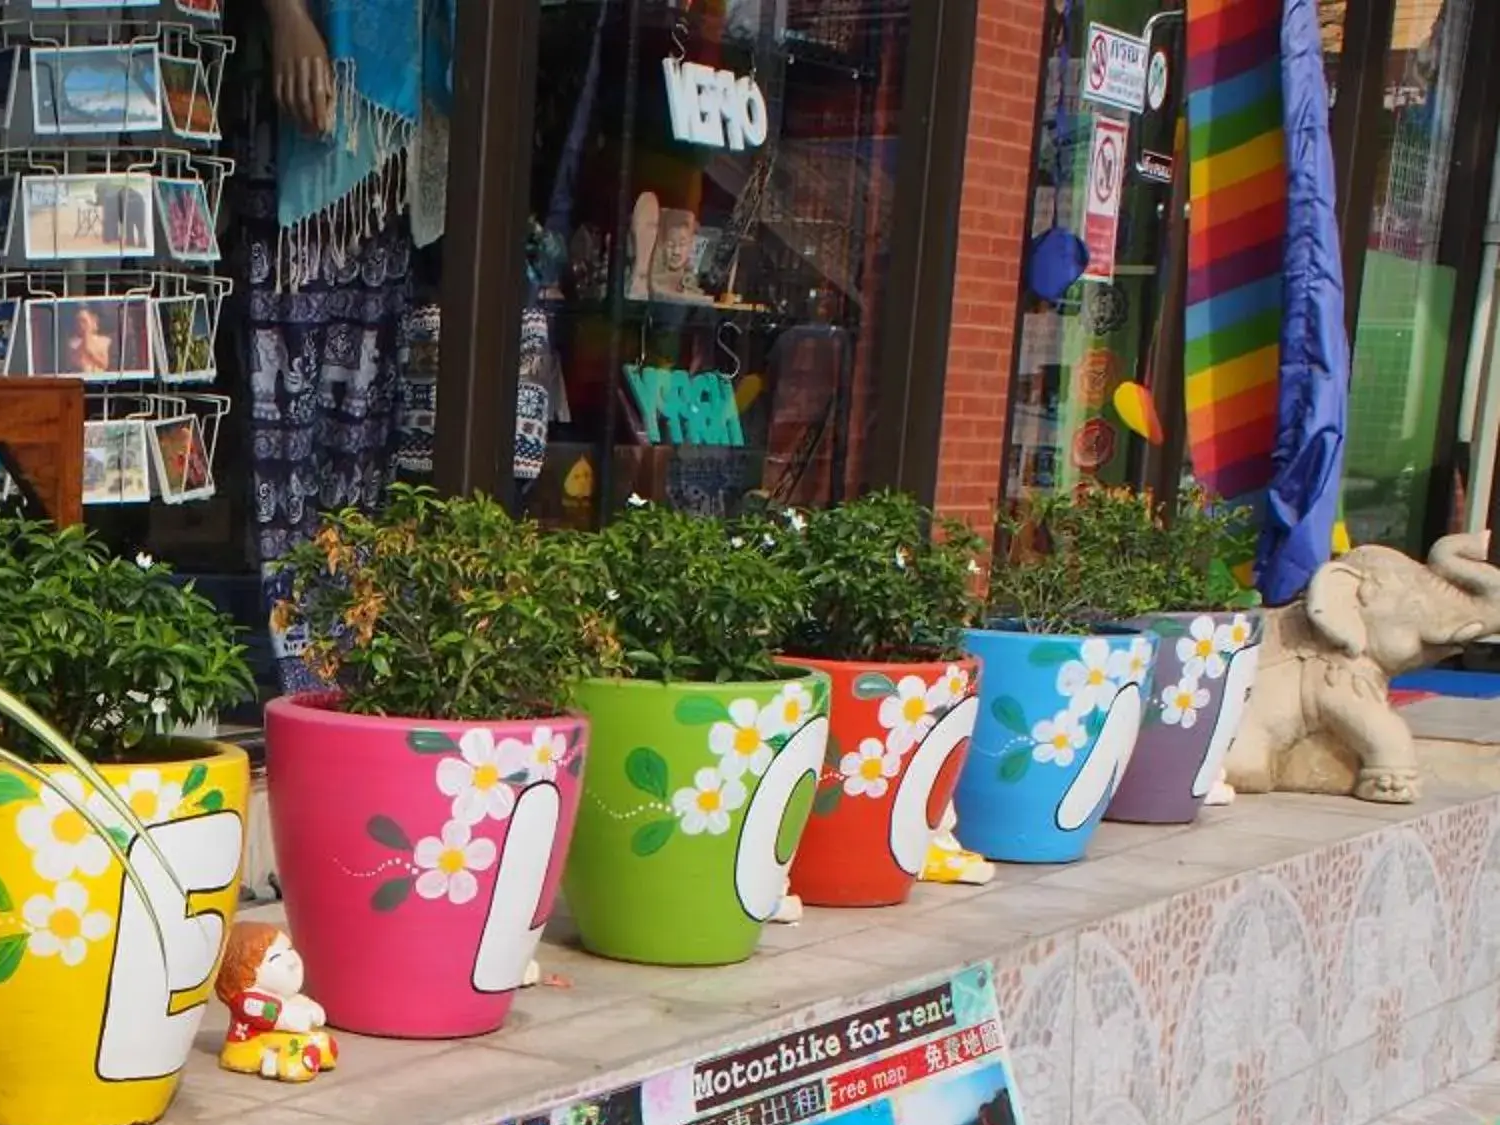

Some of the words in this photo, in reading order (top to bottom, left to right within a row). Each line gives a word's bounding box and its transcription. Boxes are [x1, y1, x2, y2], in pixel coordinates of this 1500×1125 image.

[692, 1033, 841, 1100] Motorbike
[849, 1015, 891, 1051] for
[898, 993, 954, 1033] rent
[827, 1081, 868, 1106] Free
[872, 1063, 909, 1091] map
